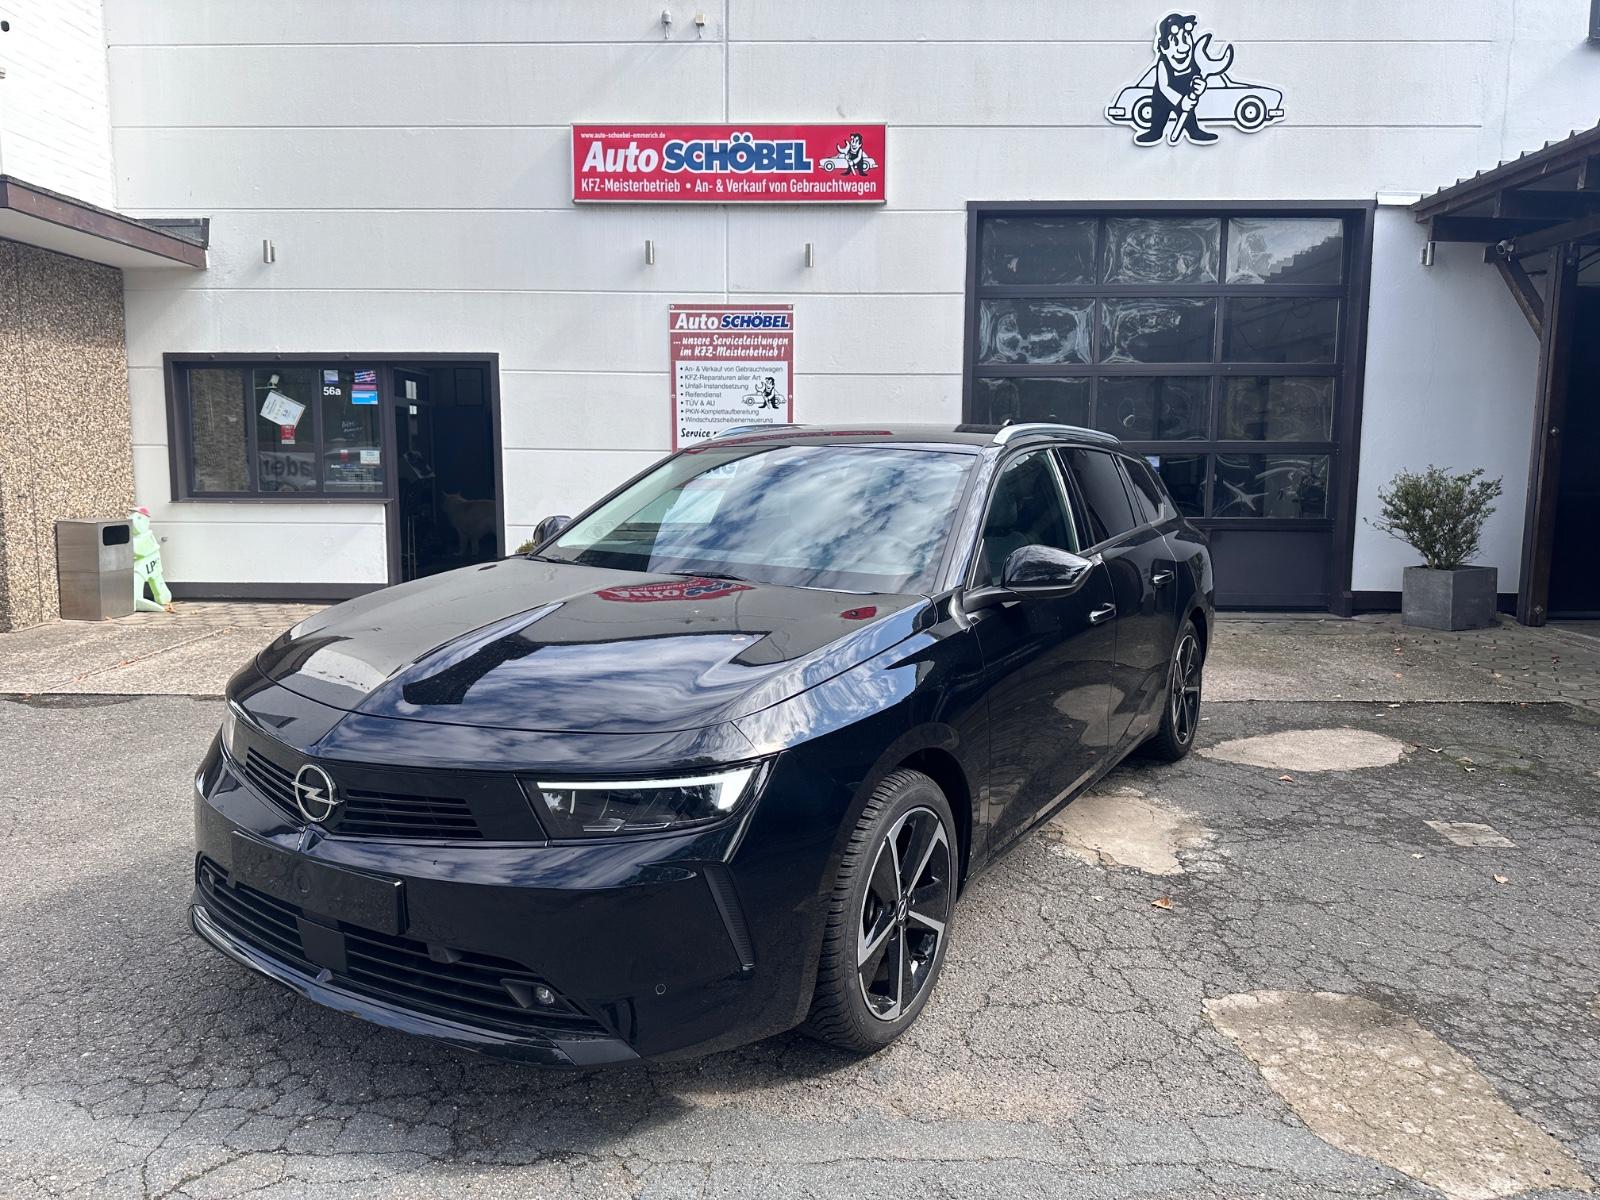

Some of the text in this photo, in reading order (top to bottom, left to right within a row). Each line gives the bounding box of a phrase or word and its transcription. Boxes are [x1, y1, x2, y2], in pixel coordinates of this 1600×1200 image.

[582, 131, 814, 173] Auto SCHÖBEL
[581, 178, 877, 196] KFZ-Meisterbetrieb An- & Verkauf von Gebrauchtwagen
[675, 312, 789, 329] Auto SCHÖBEL
[682, 336, 710, 344] unsere
[713, 334, 789, 347] Serviceleistungen
[680, 346, 692, 357] im
[694, 346, 778, 357] KFZ-Meisterbetrieb
[735, 365, 784, 374] Gebrauchtwagen
[323, 386, 341, 395] 56a
[681, 427, 710, 438] Service
